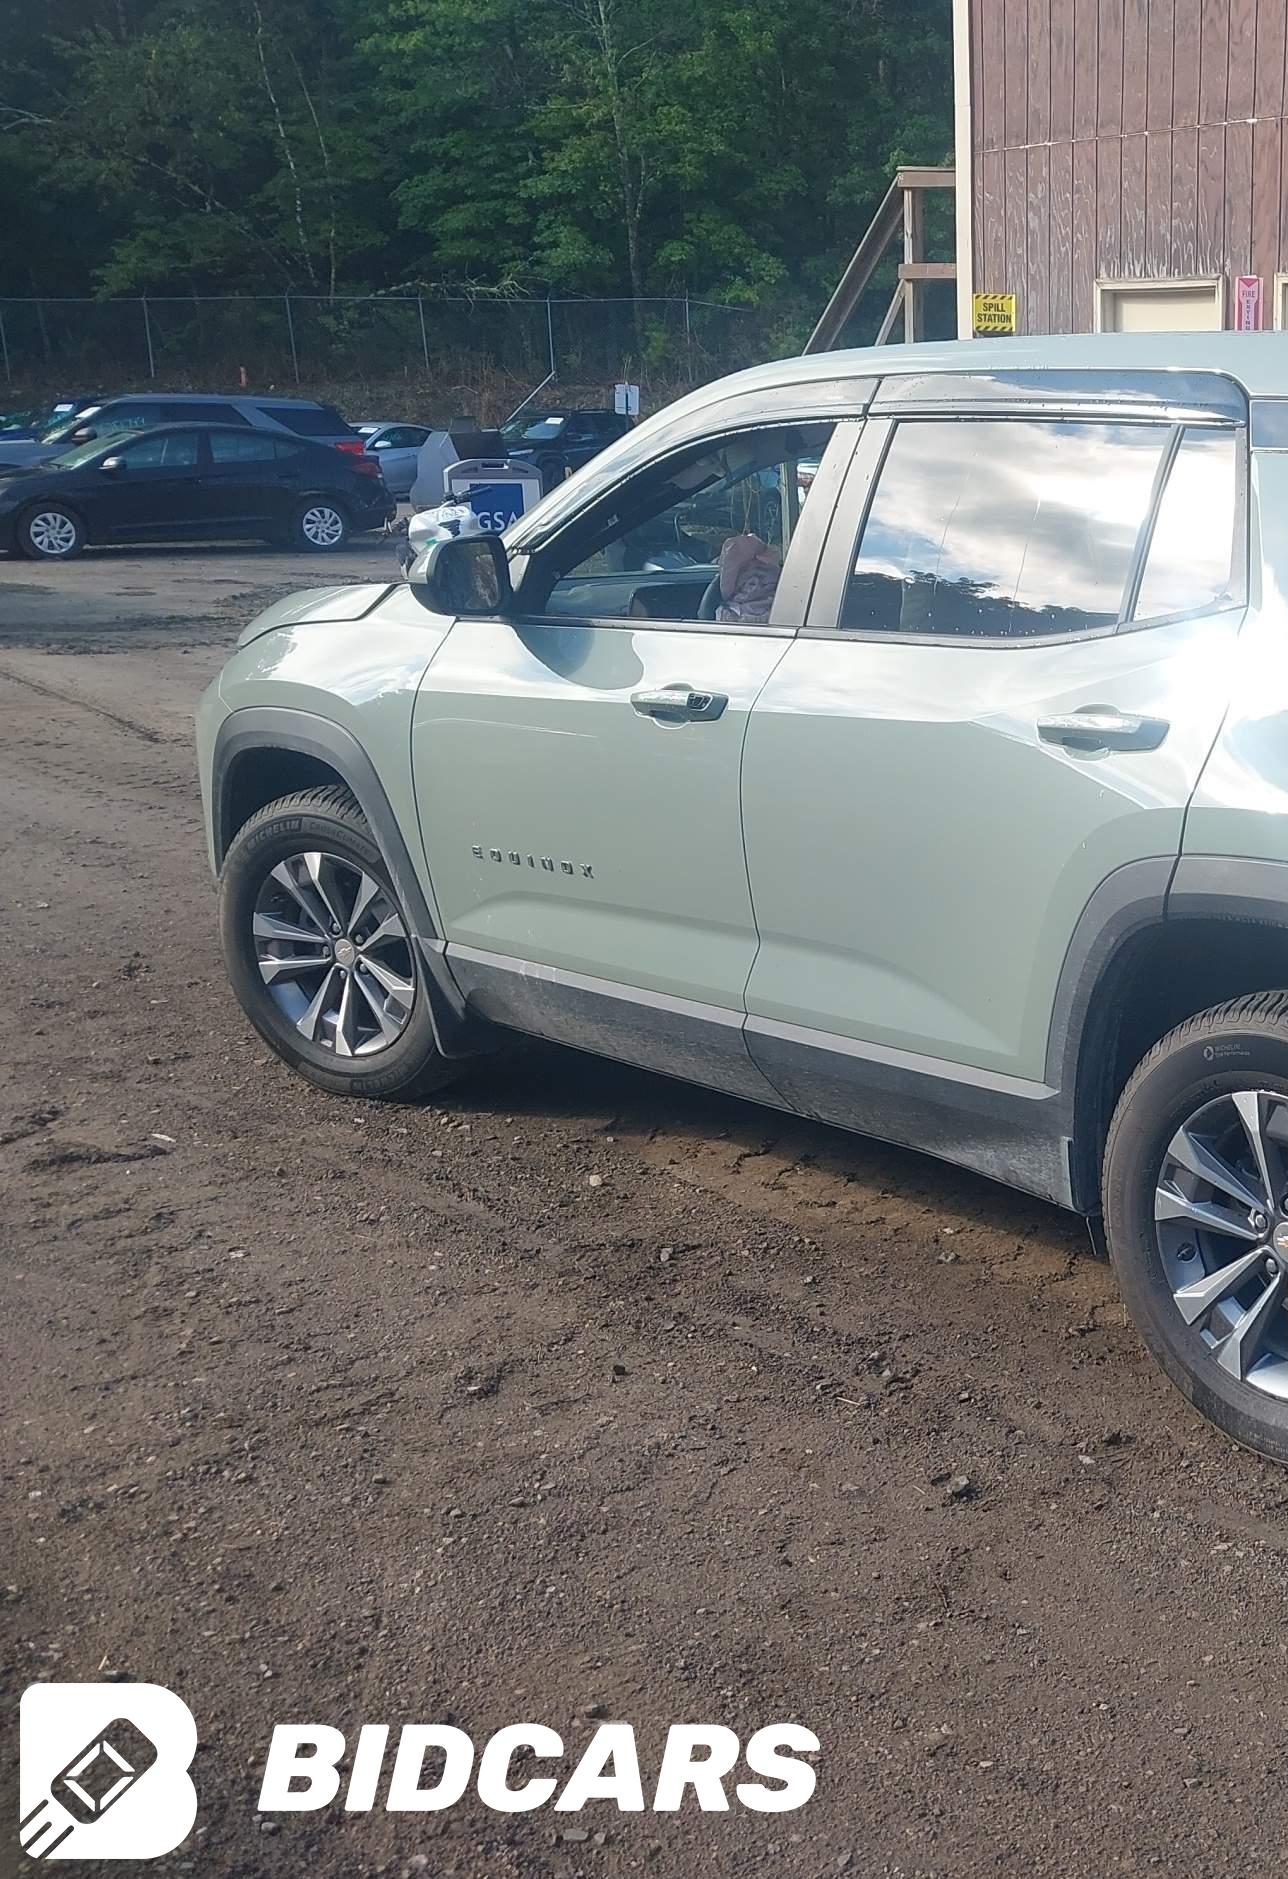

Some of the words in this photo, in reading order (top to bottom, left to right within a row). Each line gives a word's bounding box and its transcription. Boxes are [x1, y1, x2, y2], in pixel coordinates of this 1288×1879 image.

[1242, 290, 1256, 298] FIRE
[982, 302, 1006, 313] SPILL
[976, 313, 1012, 324] STATION
[472, 845, 594, 879] EQUINOX
